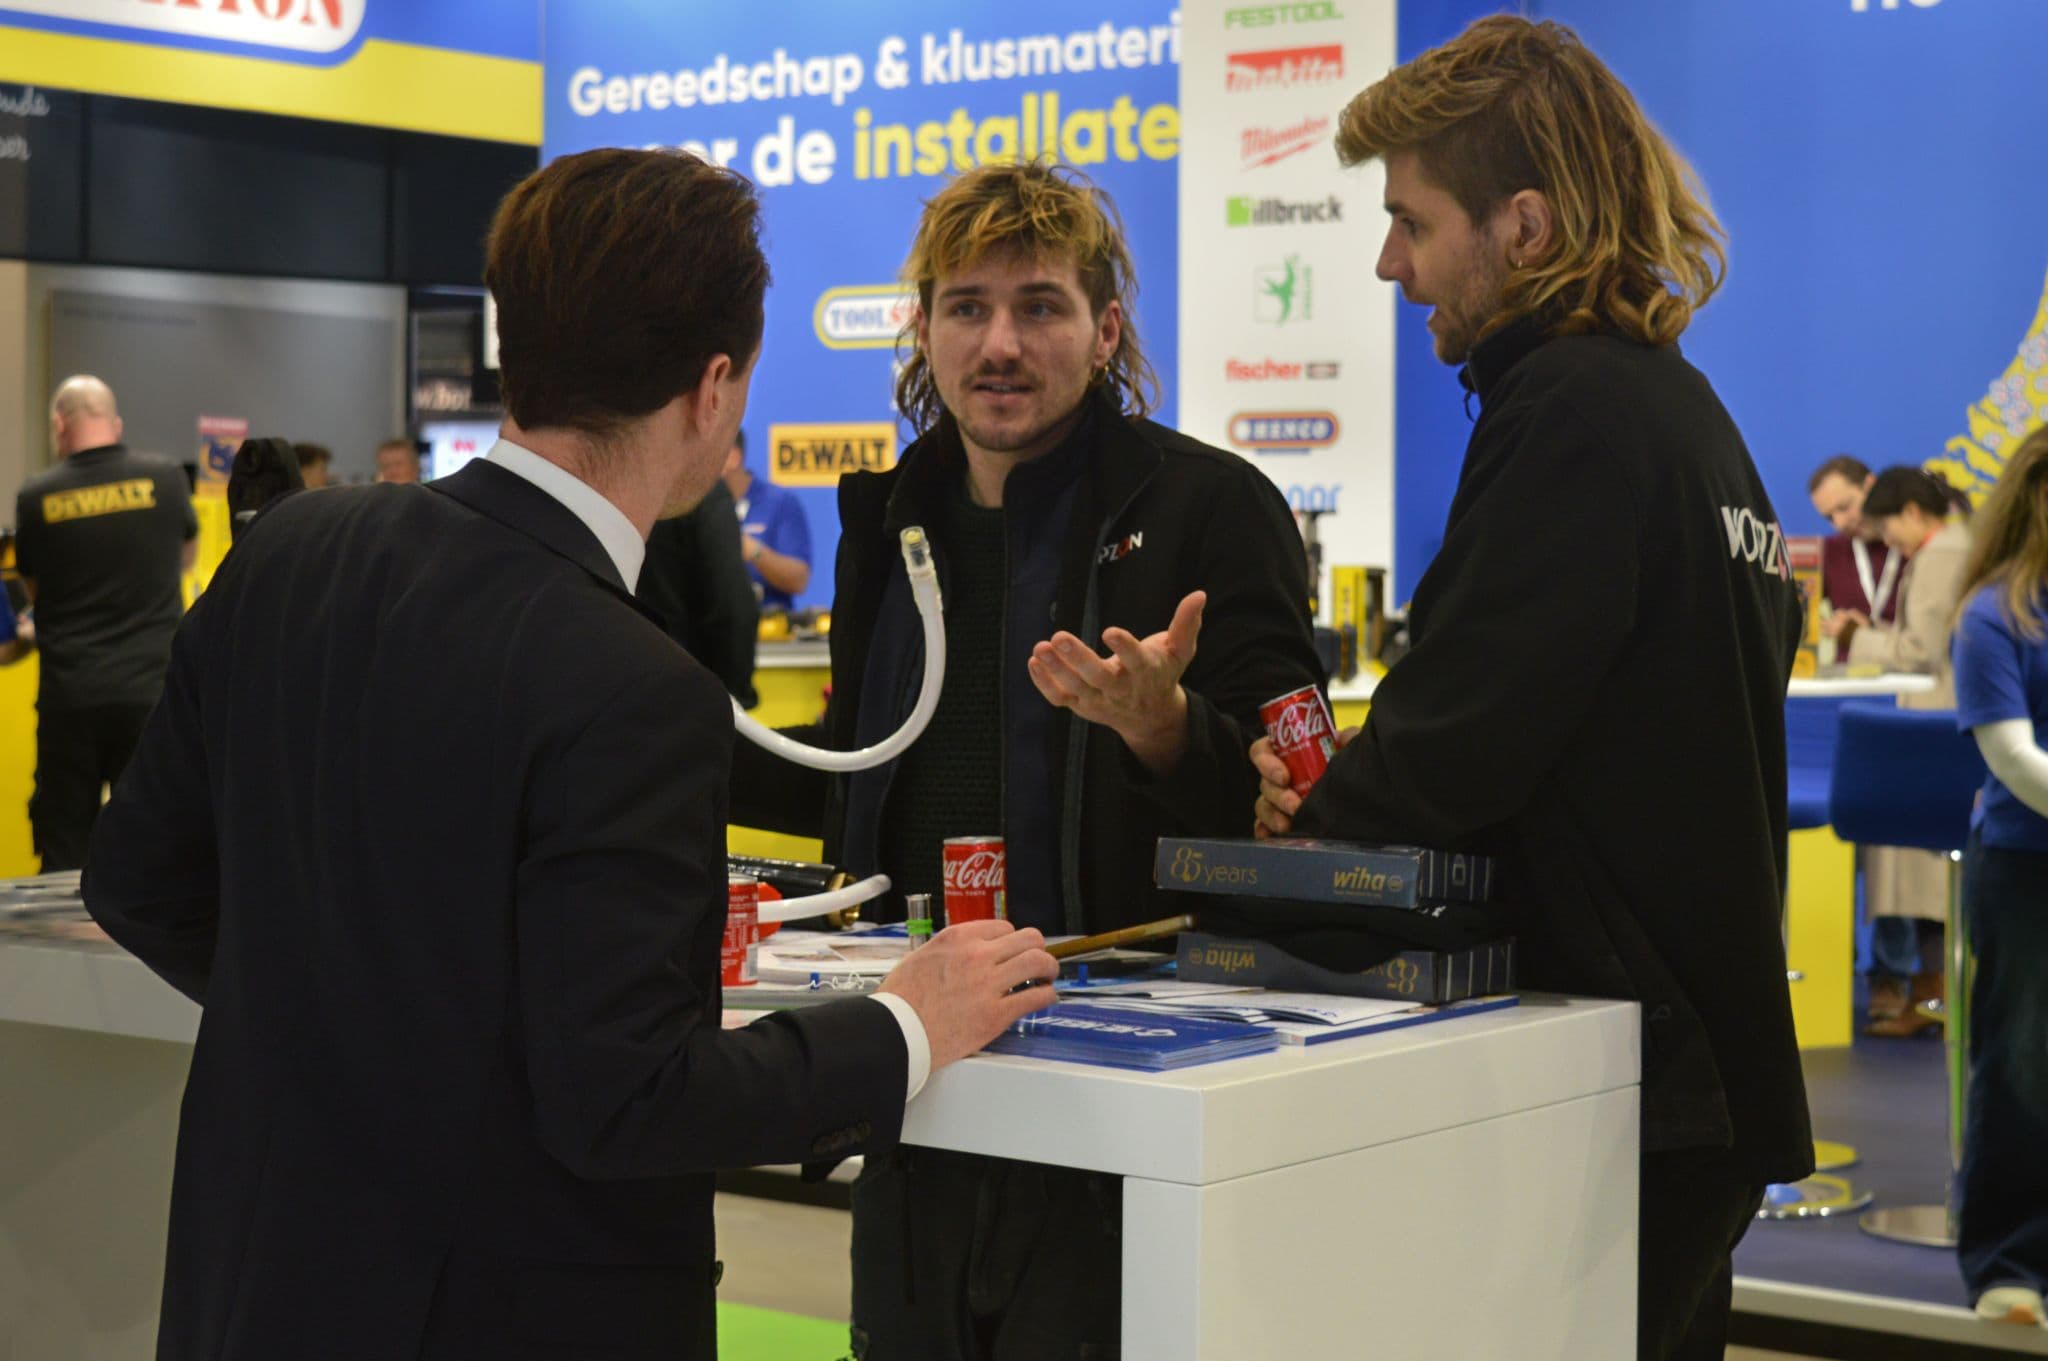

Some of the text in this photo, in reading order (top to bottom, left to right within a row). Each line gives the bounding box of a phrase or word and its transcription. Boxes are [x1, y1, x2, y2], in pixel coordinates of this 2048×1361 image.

[1225, 1, 1344, 28] FESTOOL
[569, 10, 1182, 117] Gereedschap & klusmateri
[752, 117, 836, 187] de
[854, 92, 1181, 179] installate
[1227, 358, 1302, 381] fischer
[1170, 846, 1258, 887] 85 years
[1333, 866, 1386, 892] wiha
[1206, 948, 1256, 975] wiha
